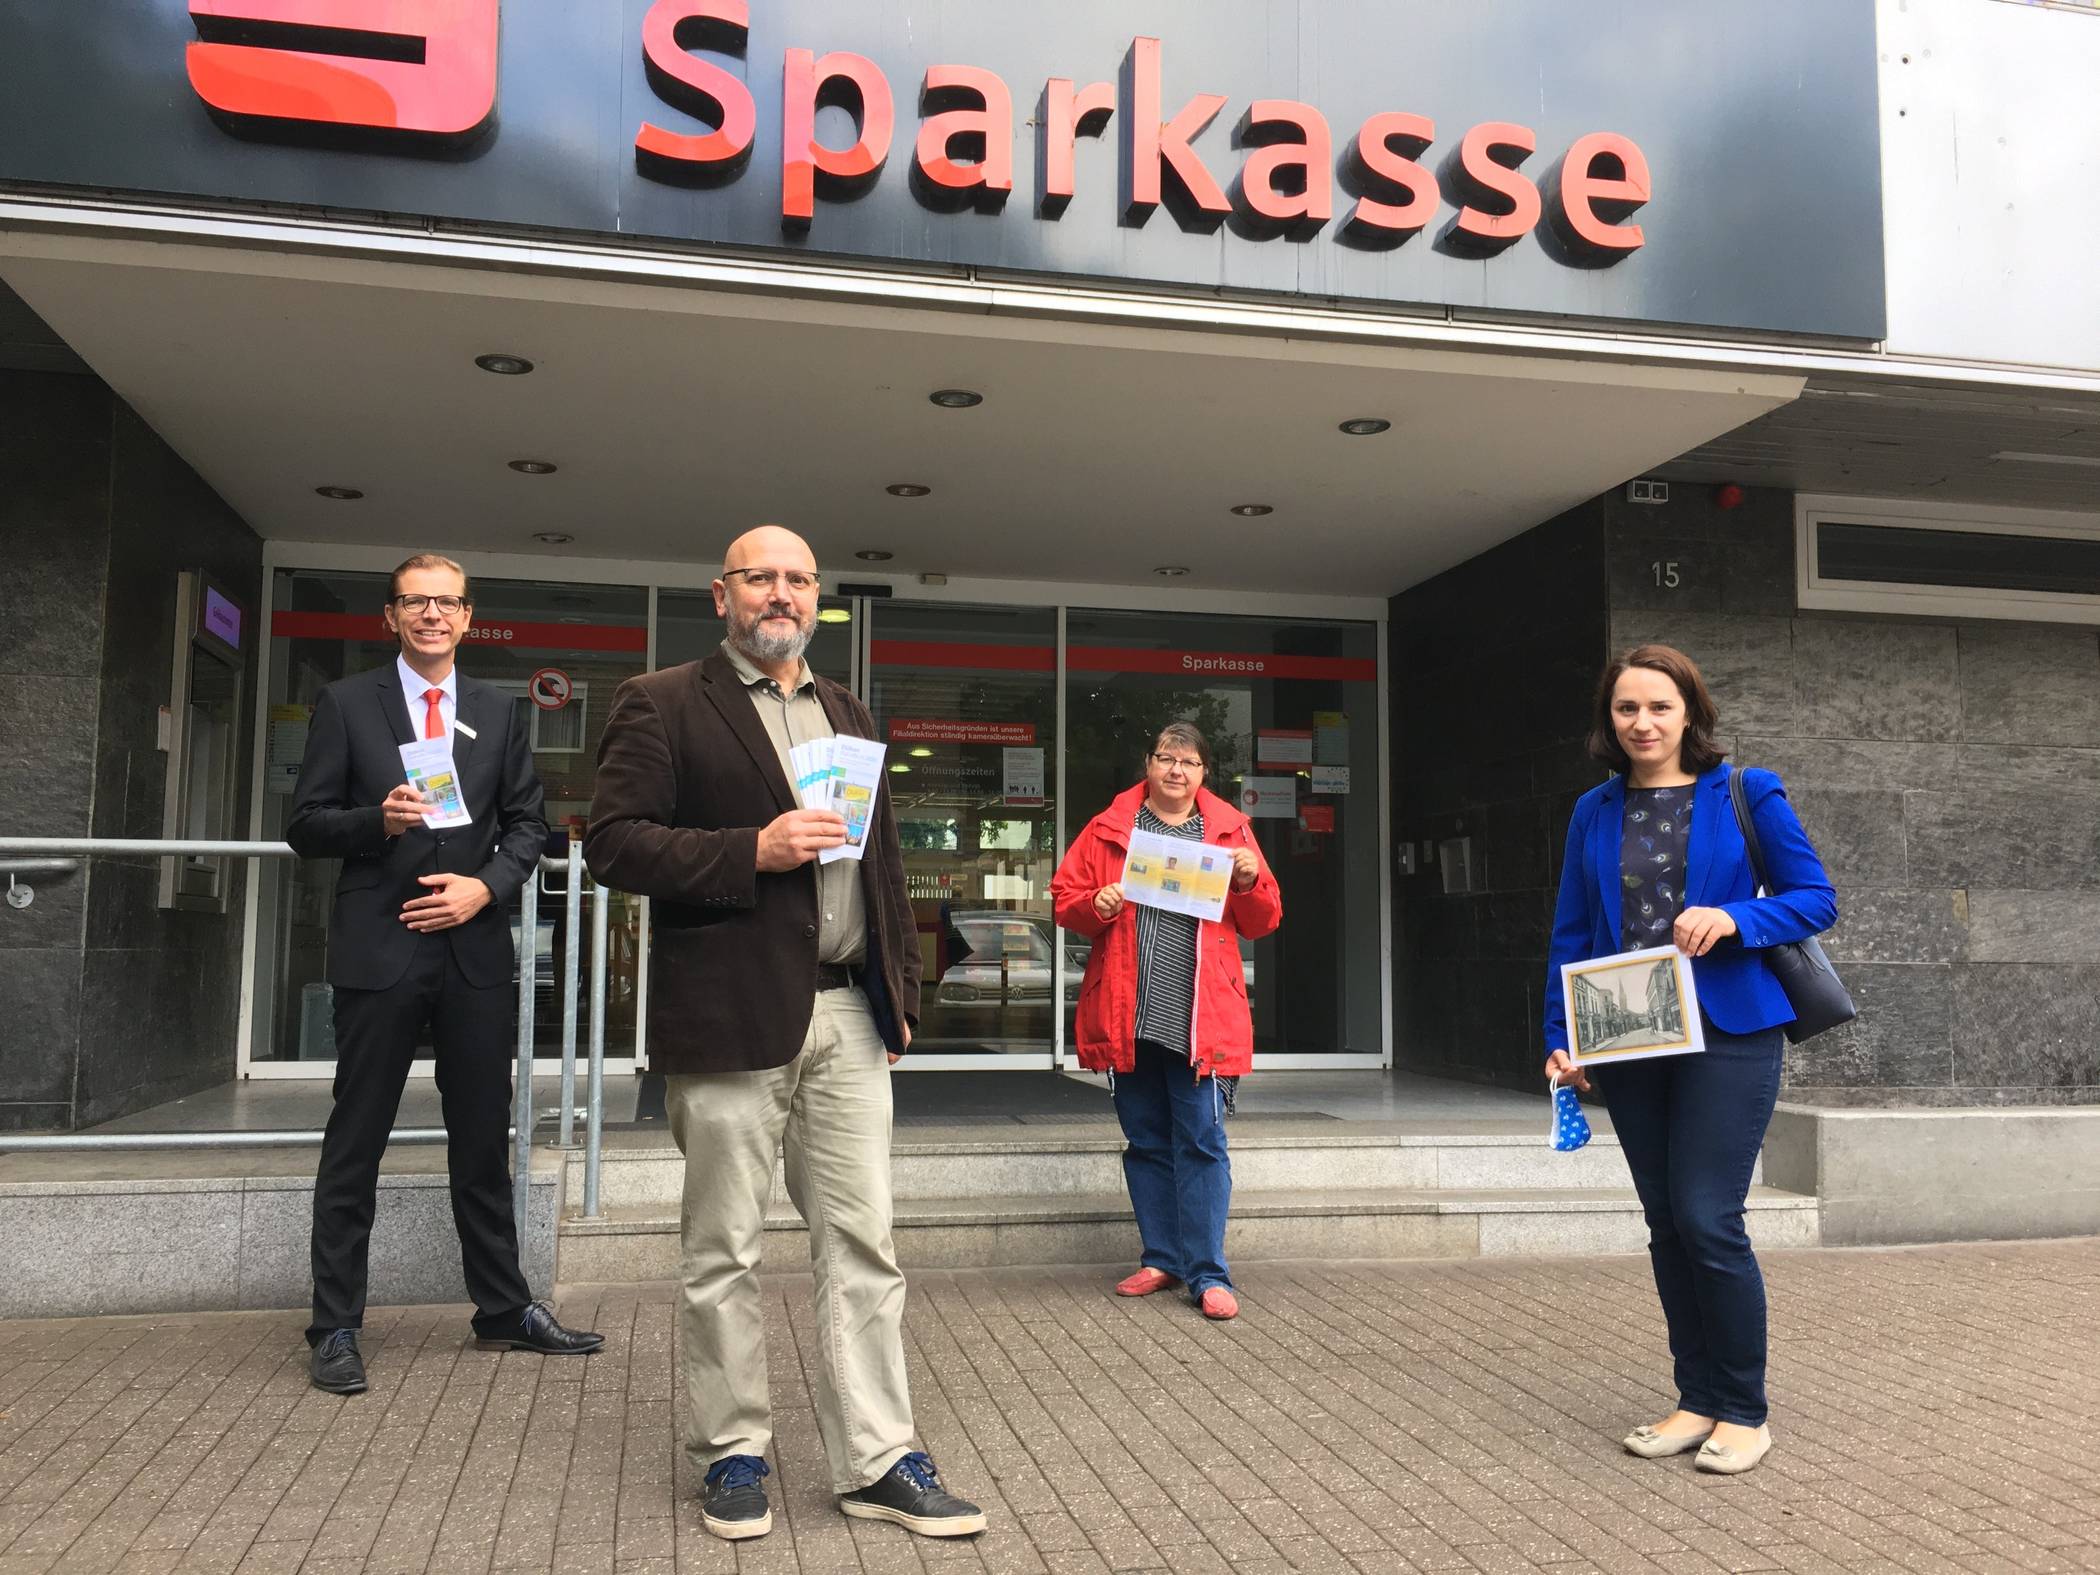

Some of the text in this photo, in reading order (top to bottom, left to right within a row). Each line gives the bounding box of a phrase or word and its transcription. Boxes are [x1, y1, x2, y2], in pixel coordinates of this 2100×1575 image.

[634, 0, 1651, 249] Sparkasse
[1652, 561, 1680, 588] 15
[1182, 655, 1265, 672] Sparkasse
[906, 722, 920, 730] Aus
[921, 722, 988, 732] Sicherheitsgründen
[990, 725, 999, 733] ist
[921, 764, 996, 778] Öffnungszeiten
